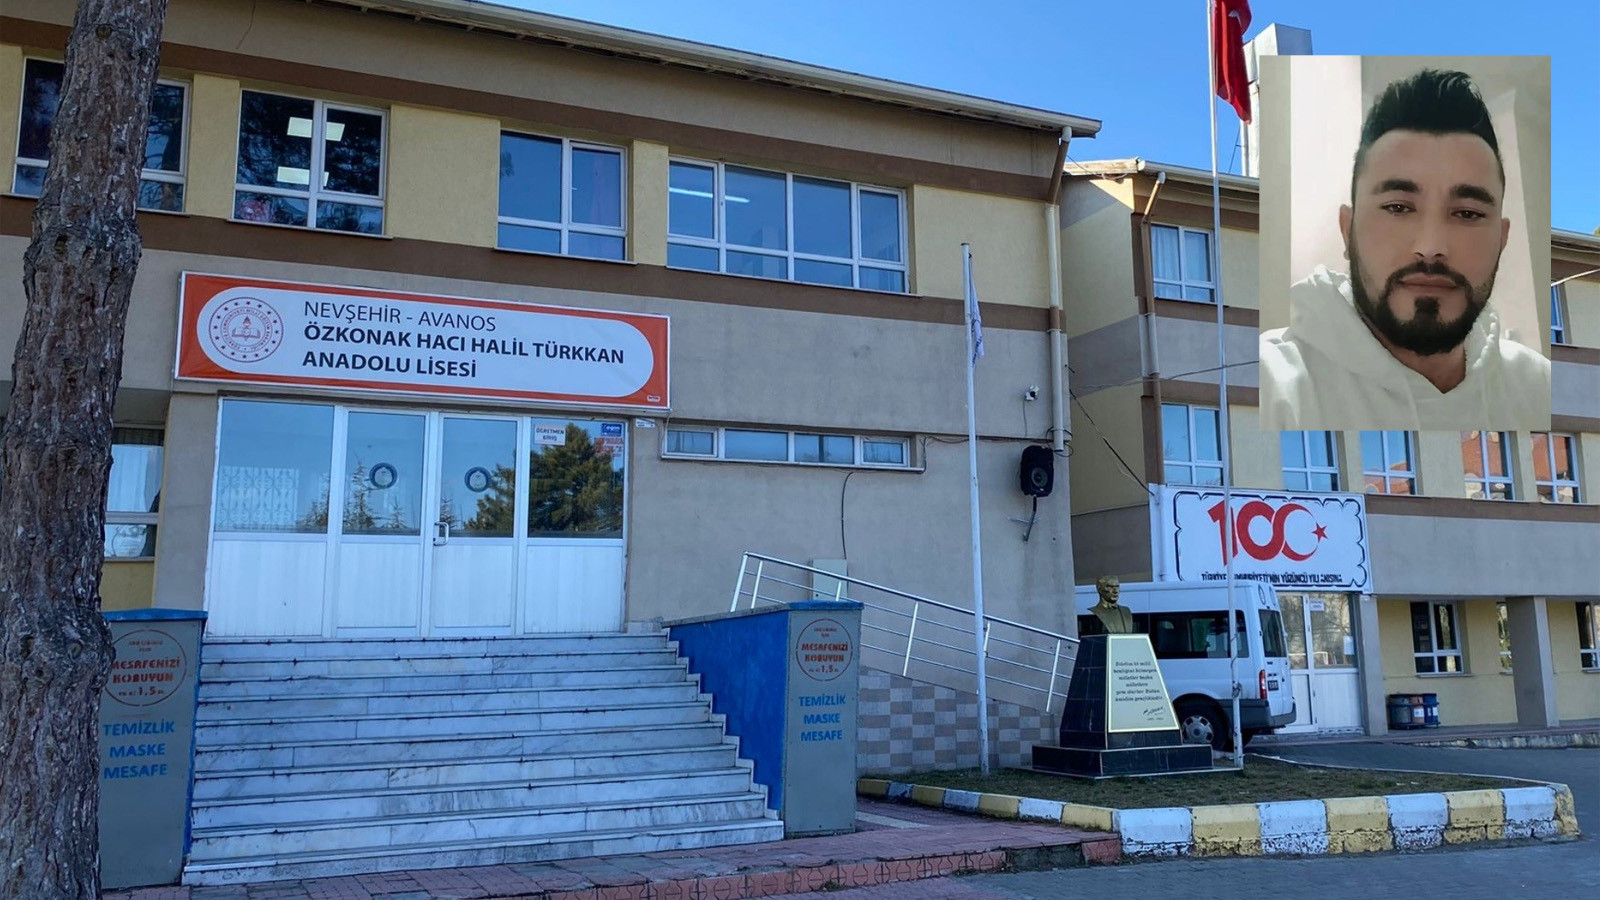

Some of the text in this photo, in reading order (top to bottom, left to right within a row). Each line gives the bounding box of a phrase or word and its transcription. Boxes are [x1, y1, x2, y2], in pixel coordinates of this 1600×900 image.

[304, 301, 400, 324] NEVŞEHİR
[418, 311, 496, 332] AVANOS
[304, 321, 624, 364] ÖZKONAK HACI HALİL TÜRKKAN
[302, 351, 477, 378] ANADOLU LİSESİ
[799, 693, 846, 707] TEMİZLİK
[803, 713, 840, 724] MASKE
[103, 719, 175, 736] TEMİZLİK
[801, 730, 843, 741] MESAFE
[109, 743, 166, 758] MASKE
[104, 763, 168, 779] MESAFE
